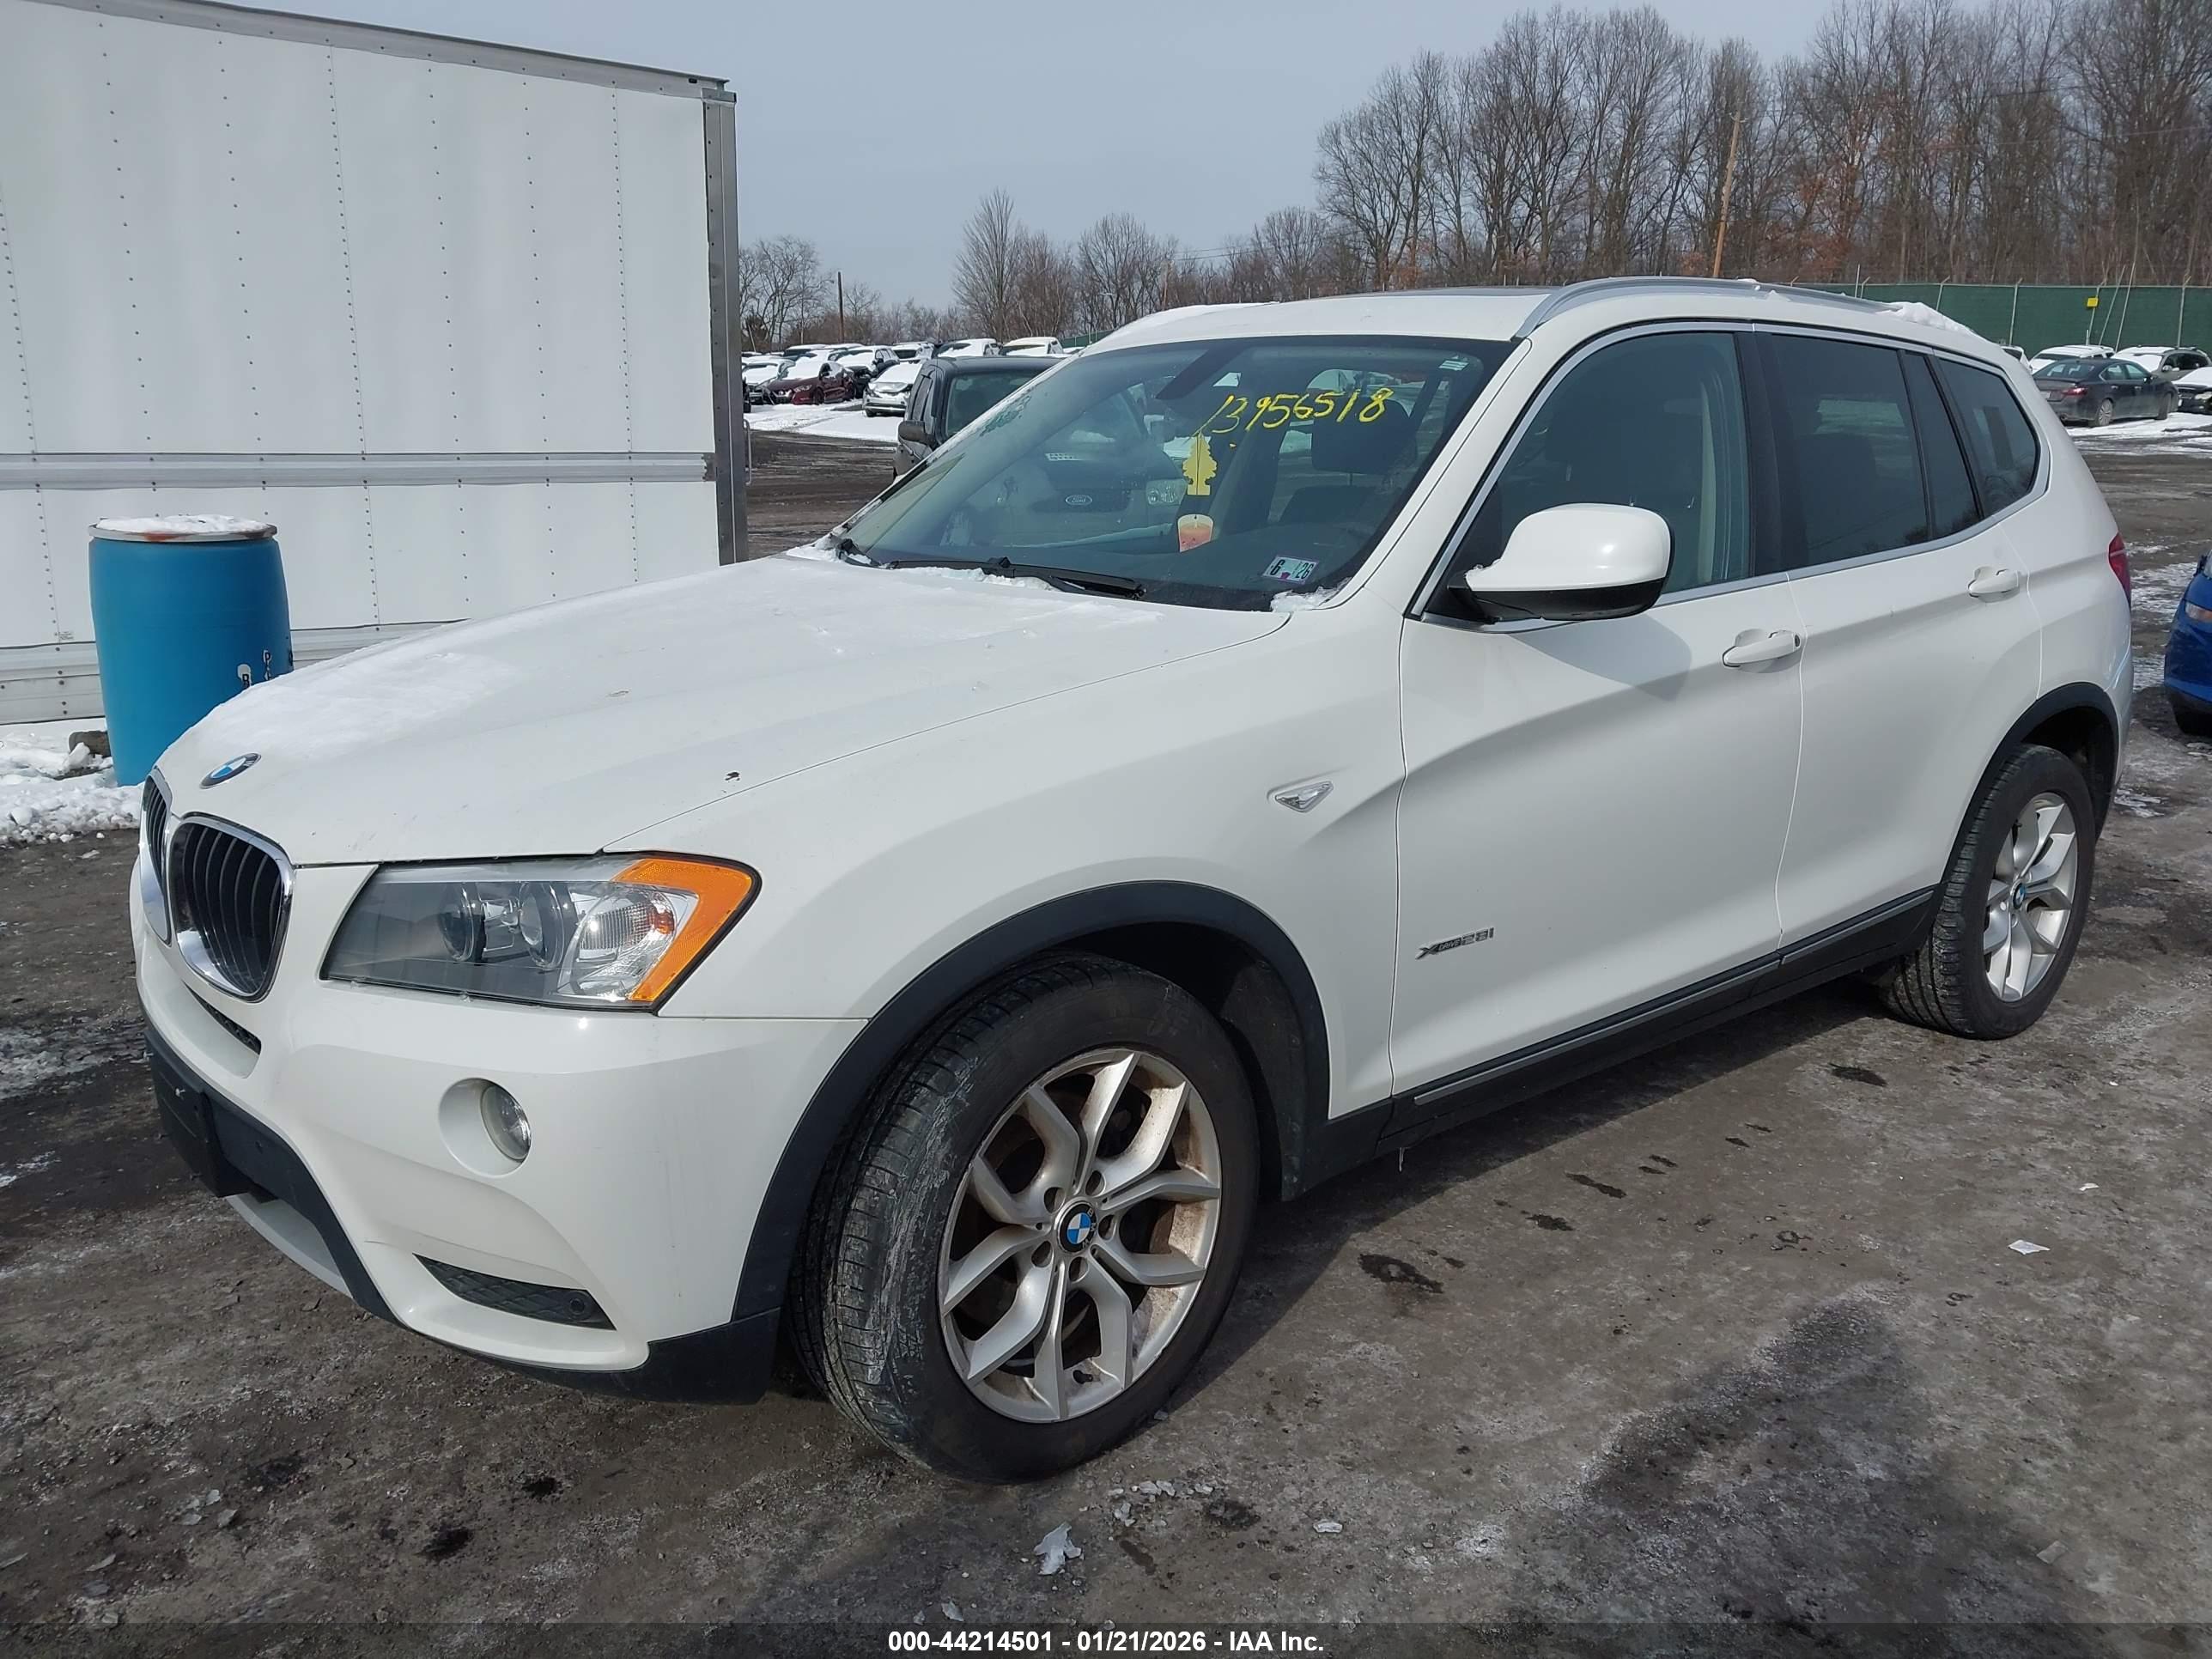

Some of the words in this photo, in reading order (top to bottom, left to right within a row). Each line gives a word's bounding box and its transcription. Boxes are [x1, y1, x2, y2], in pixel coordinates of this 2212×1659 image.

[1192, 386, 1395, 435] 13956518
[1270, 559, 1286, 576] 6
[1295, 562, 1315, 580] 26
